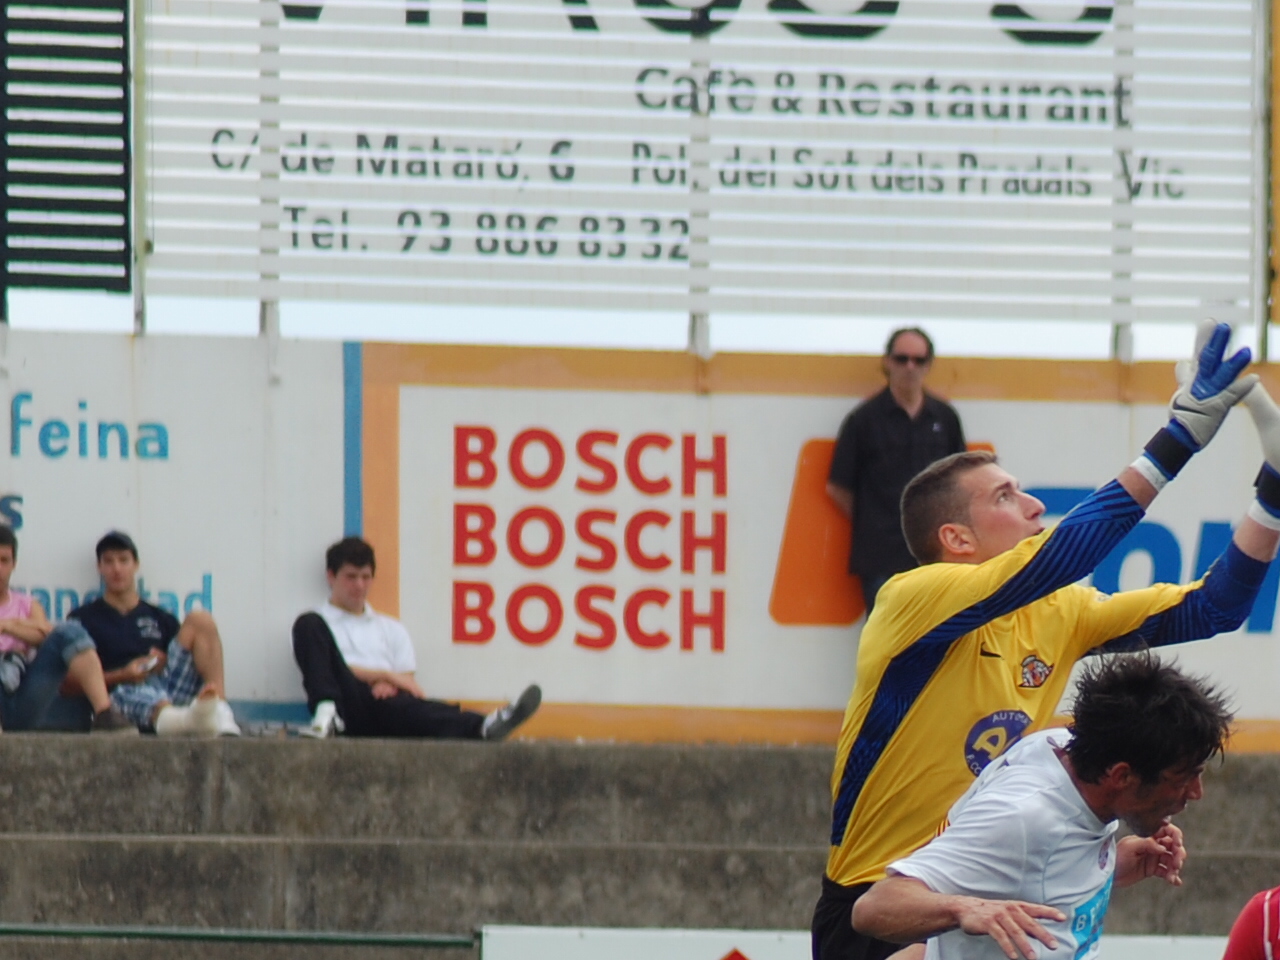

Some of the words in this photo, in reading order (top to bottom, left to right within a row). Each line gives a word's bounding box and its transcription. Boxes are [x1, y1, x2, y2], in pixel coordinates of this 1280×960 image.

[770, 72, 803, 113] &
[817, 72, 1131, 127] Restaurant
[280, 132, 335, 175] de
[717, 145, 777, 189] del
[792, 147, 860, 191] Sot
[870, 149, 945, 194] dels
[1119, 150, 1186, 200] Vic
[282, 205, 369, 251] Tel.
[396, 210, 452, 253] 93
[474, 213, 559, 257] 886
[577, 215, 626, 258] 83
[640, 218, 690, 261] 32
[10, 391, 170, 460] feina
[453, 425, 728, 497] BOSCH
[452, 502, 727, 574] BOSCH
[451, 580, 726, 652] BOSCH
